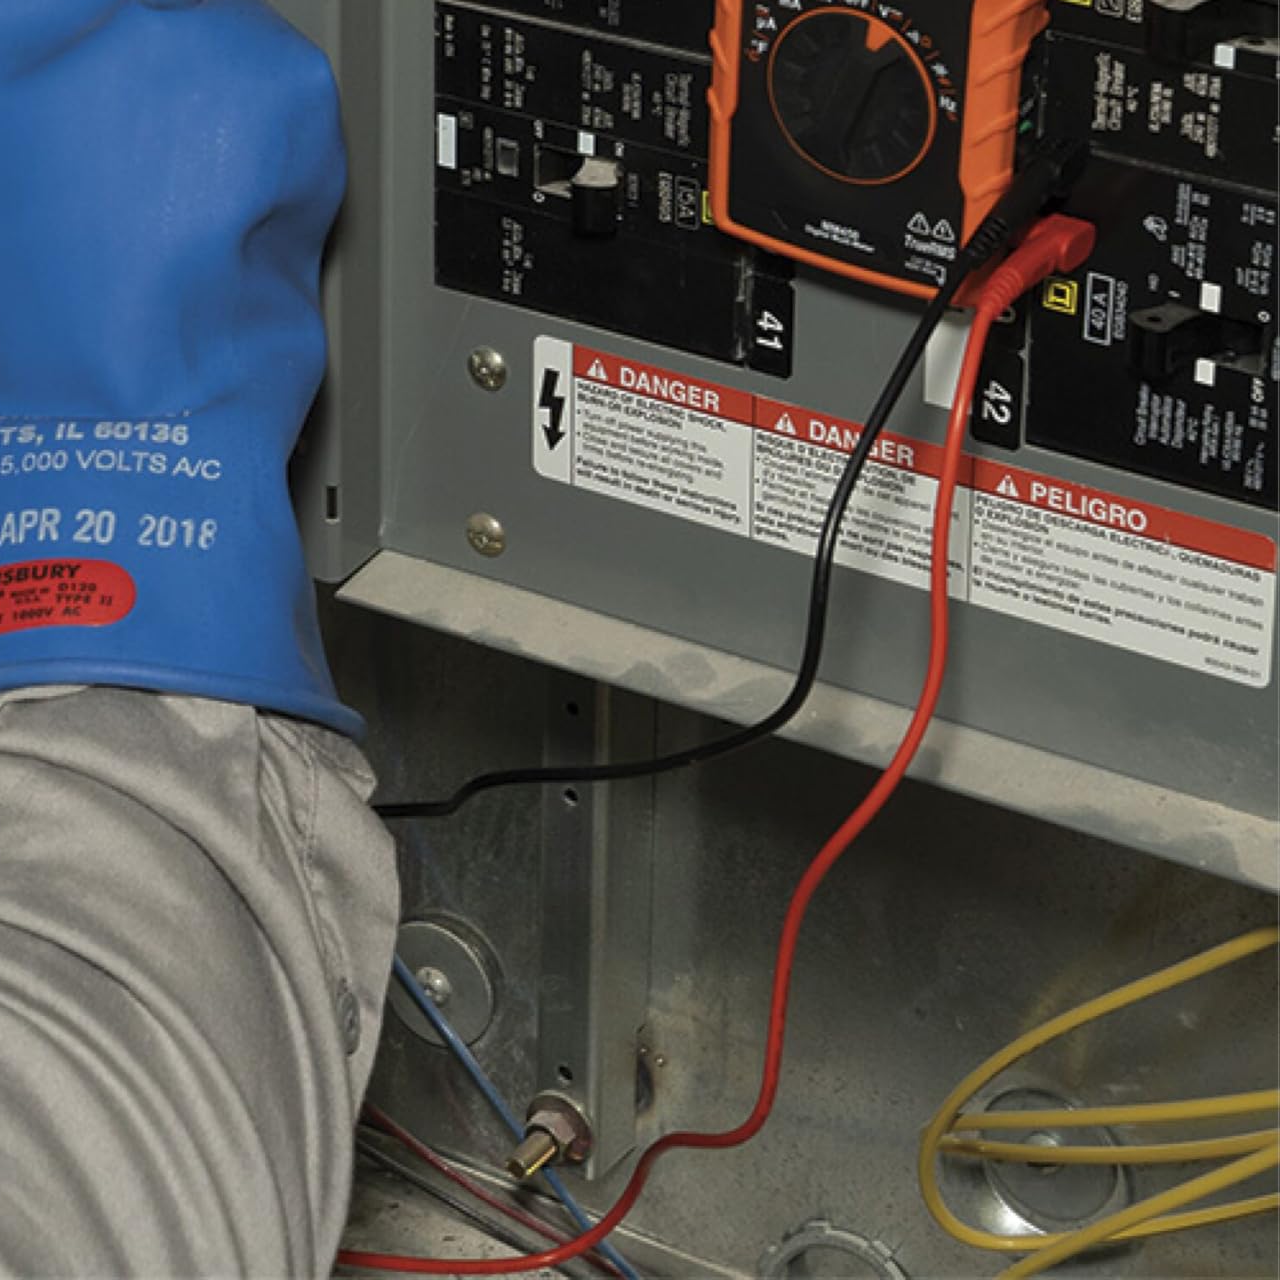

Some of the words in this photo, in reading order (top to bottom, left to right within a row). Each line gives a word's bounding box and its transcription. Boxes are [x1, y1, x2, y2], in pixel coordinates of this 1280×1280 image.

[756, 310, 784, 351] 41
[619, 366, 720, 413] DANGER
[981, 380, 1012, 425] 42
[1250, 377, 1264, 403] OFF
[56, 423, 85, 442] IL
[93, 421, 190, 446] 60136
[75, 450, 167, 475] VOLTS
[171, 457, 221, 481] A/C
[1030, 482, 1147, 533] PELIGRO
[72, 509, 116, 545] 20
[137, 514, 218, 550] 2018
